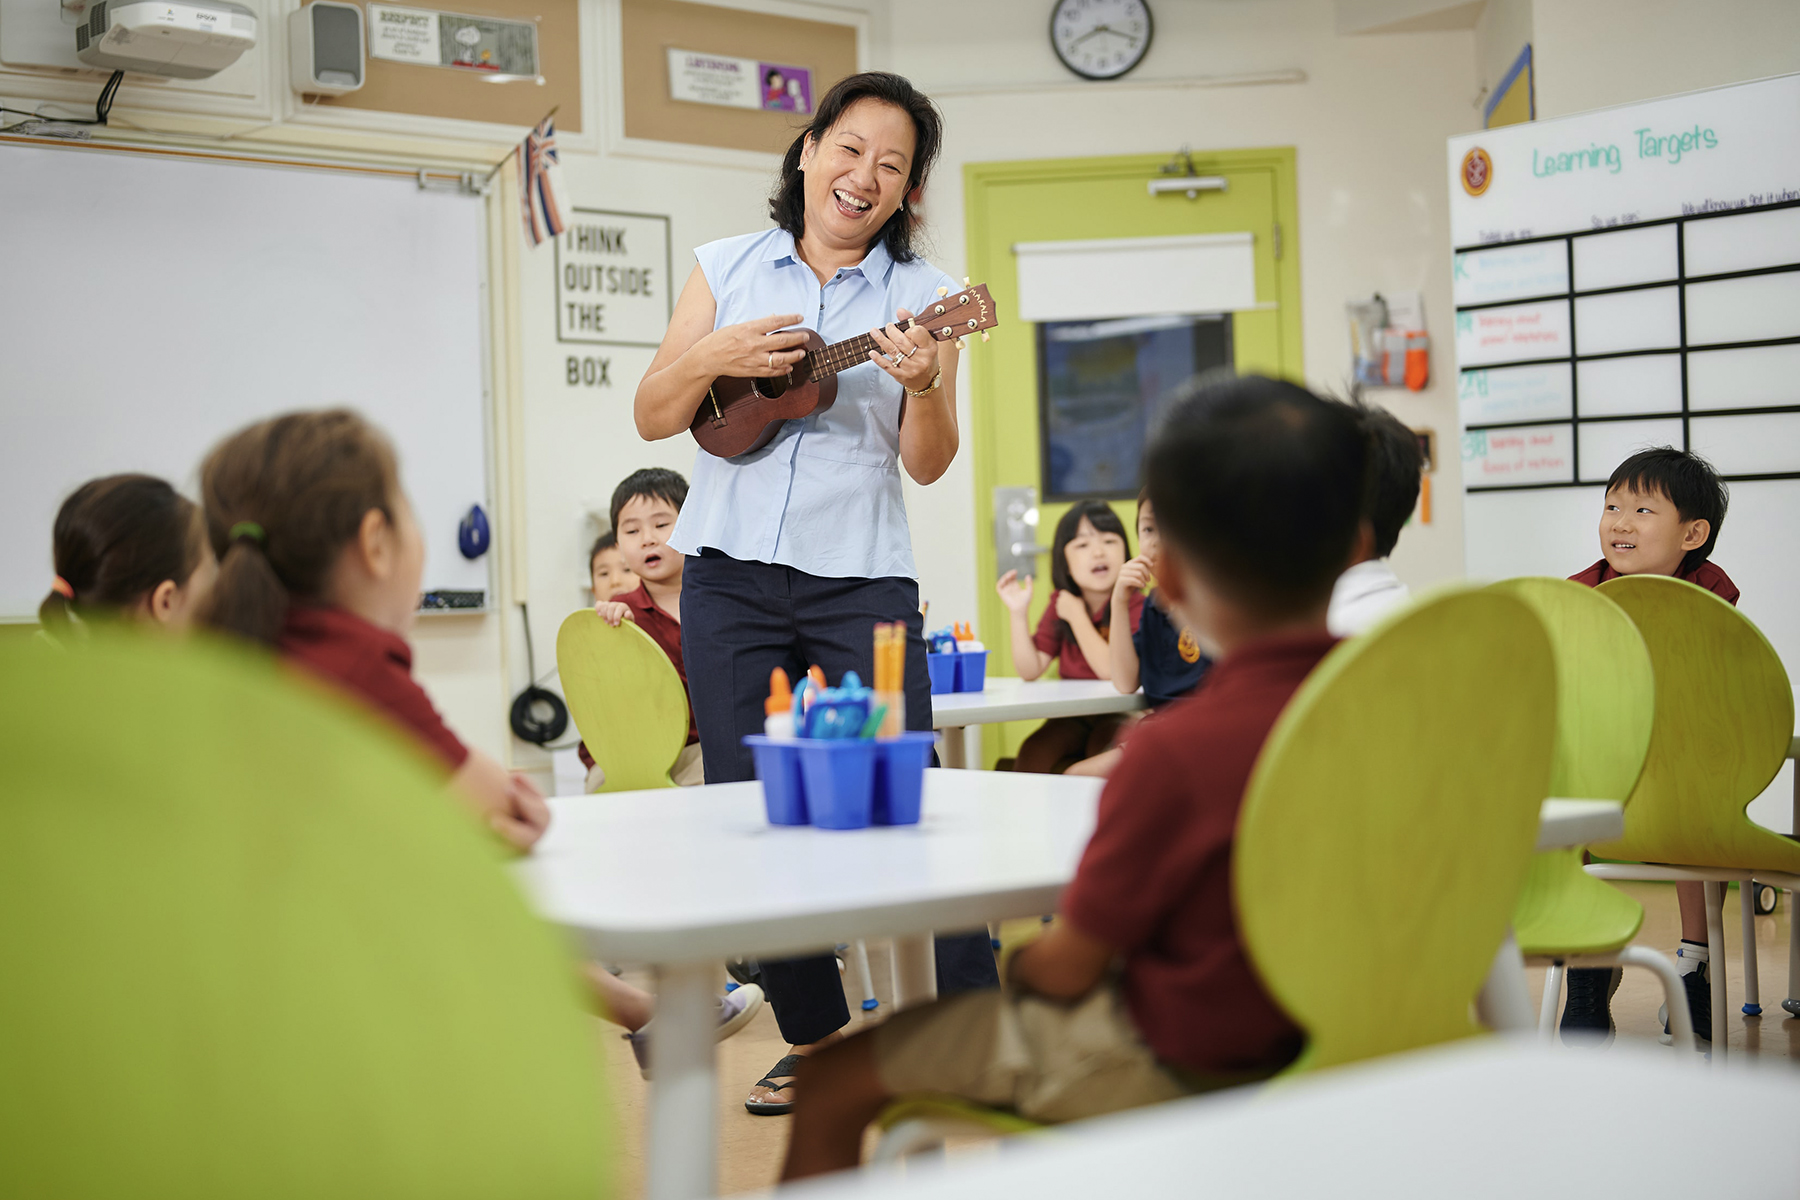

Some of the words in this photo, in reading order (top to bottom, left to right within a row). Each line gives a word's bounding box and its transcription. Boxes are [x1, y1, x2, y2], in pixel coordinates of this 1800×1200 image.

[196, 13, 218, 22] EPSON
[1533, 143, 1622, 178] Learning
[1634, 125, 1718, 165] Targets
[564, 263, 653, 296] OUTSIDE
[1454, 253, 1469, 281] K
[566, 302, 605, 333] THE
[969, 289, 988, 323] MAKALA
[566, 356, 612, 387] BOX
